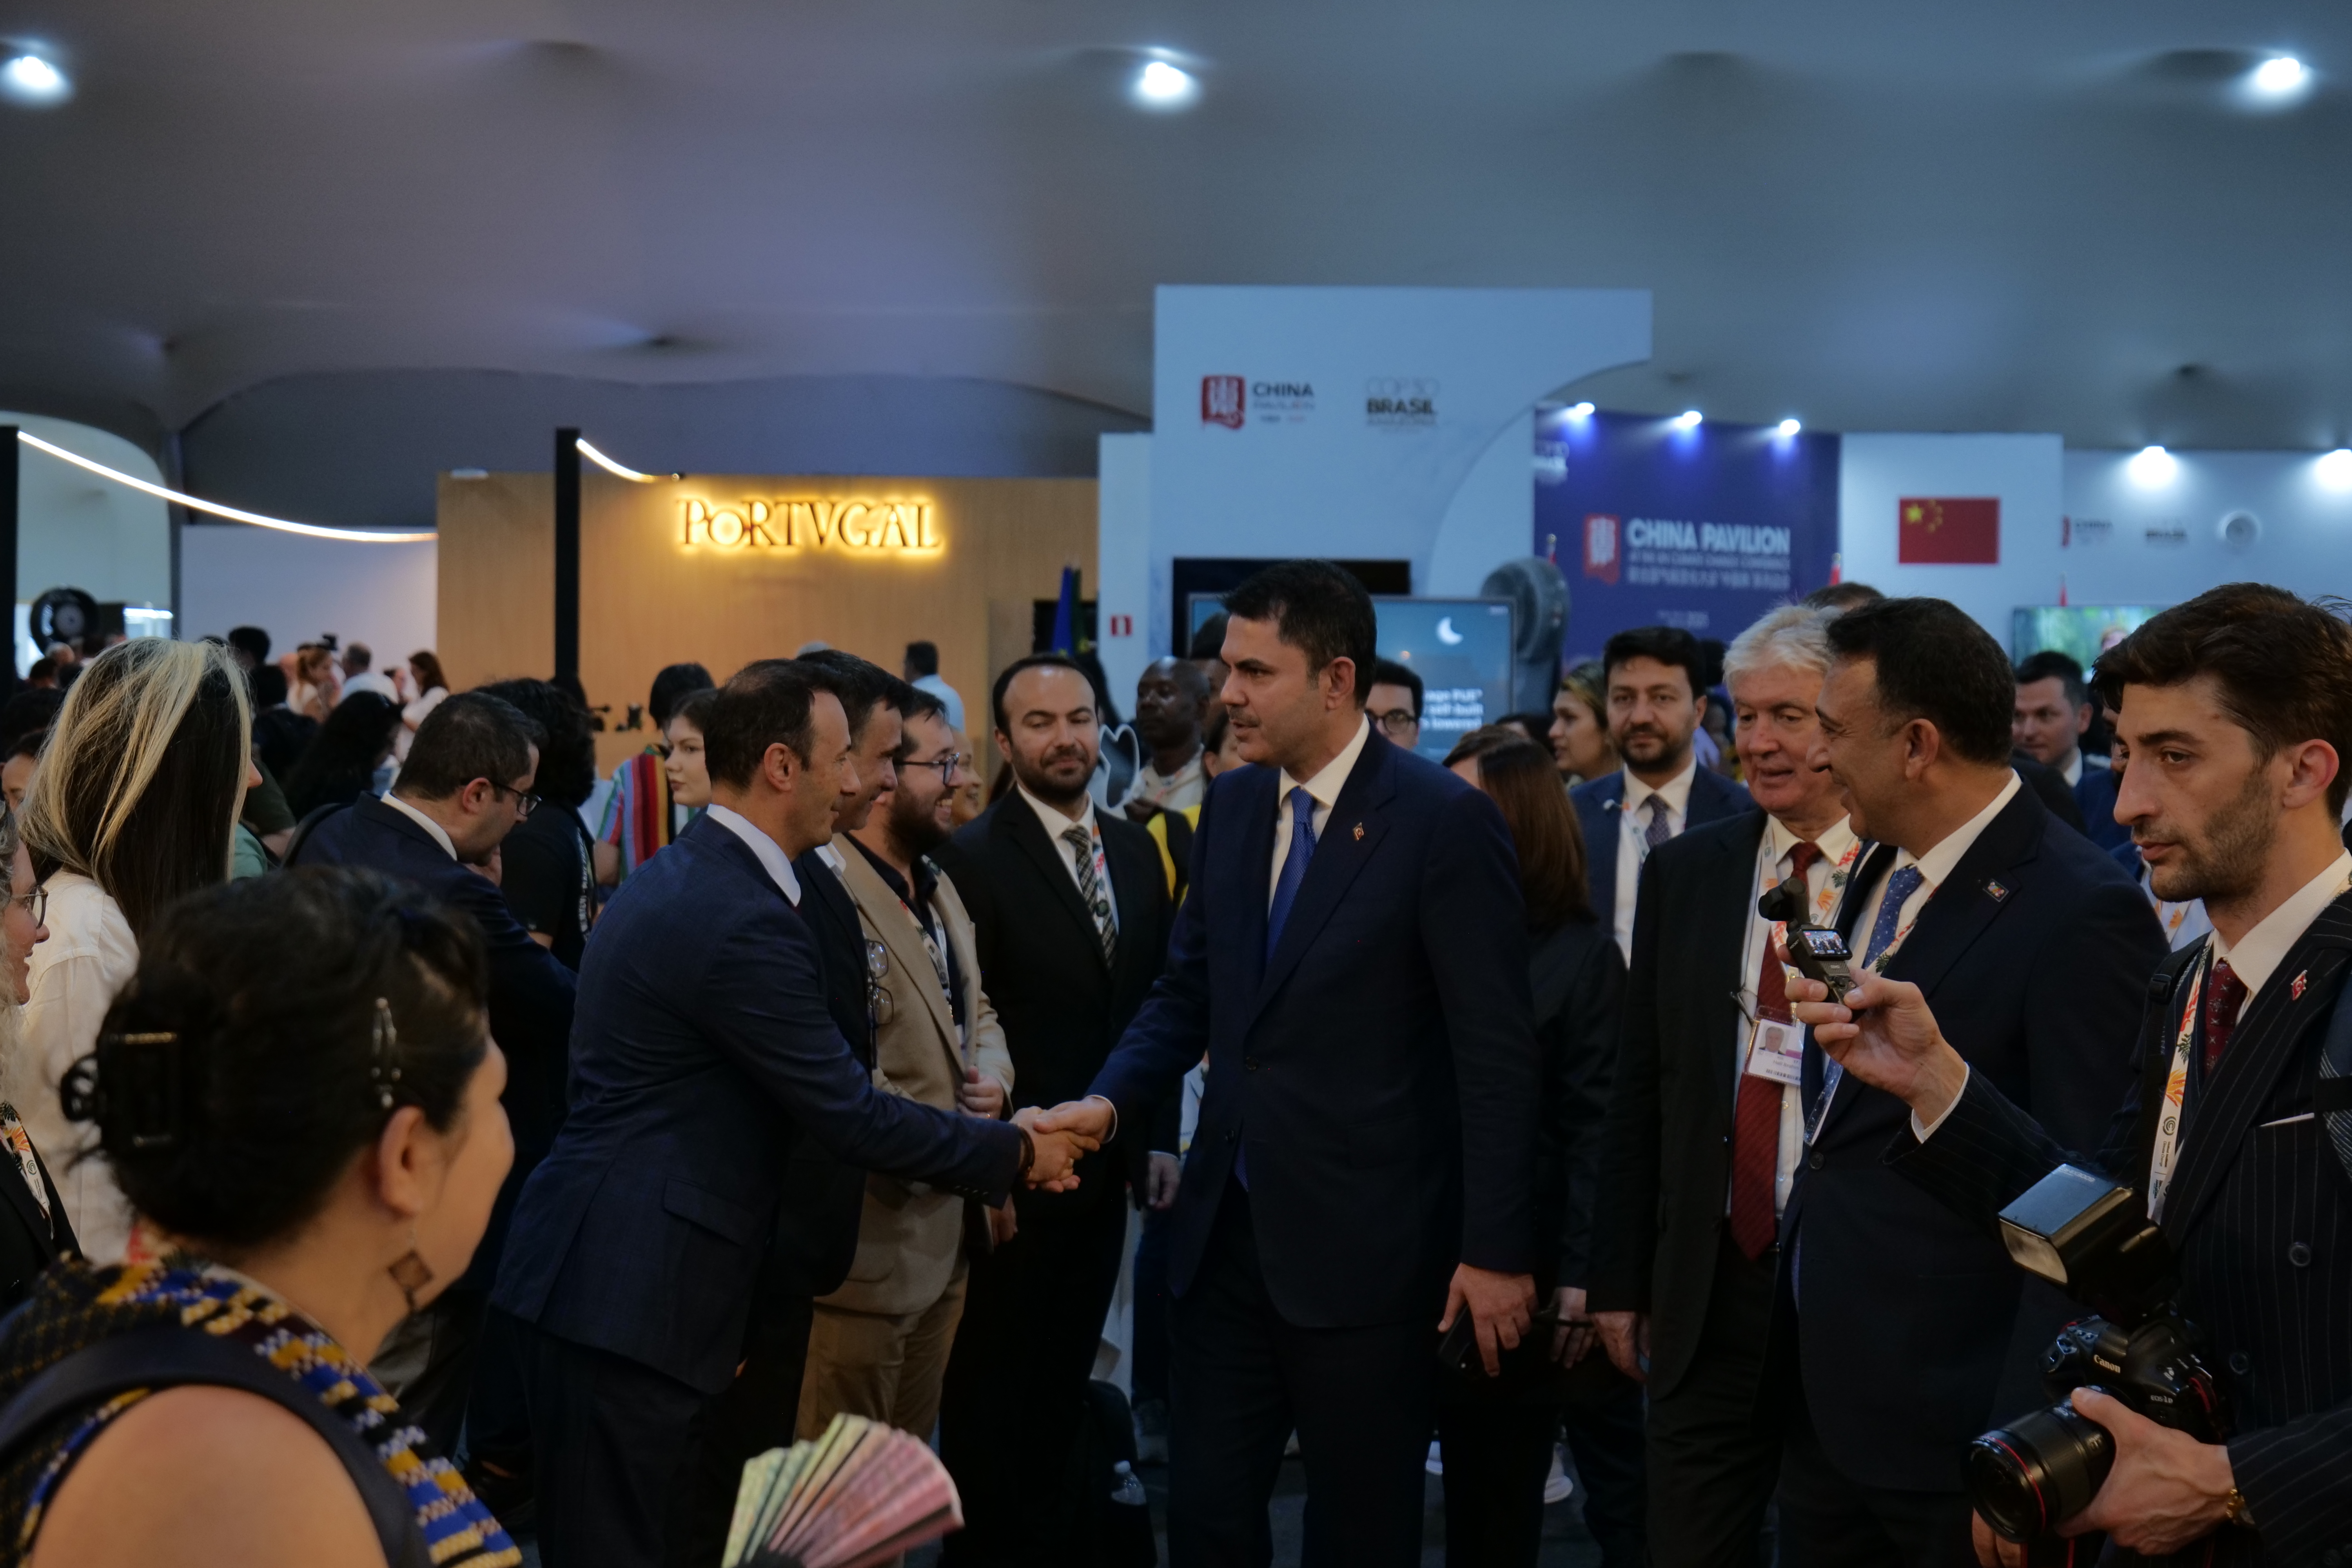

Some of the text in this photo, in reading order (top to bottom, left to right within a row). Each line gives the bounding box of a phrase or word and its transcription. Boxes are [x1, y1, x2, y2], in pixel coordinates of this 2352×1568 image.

[1253, 383, 1313, 397] CHINA
[1367, 397, 1436, 414] BRASIL
[1628, 518, 1790, 554] CHINA PAVILION
[2093, 1354, 2121, 1374] Canon
